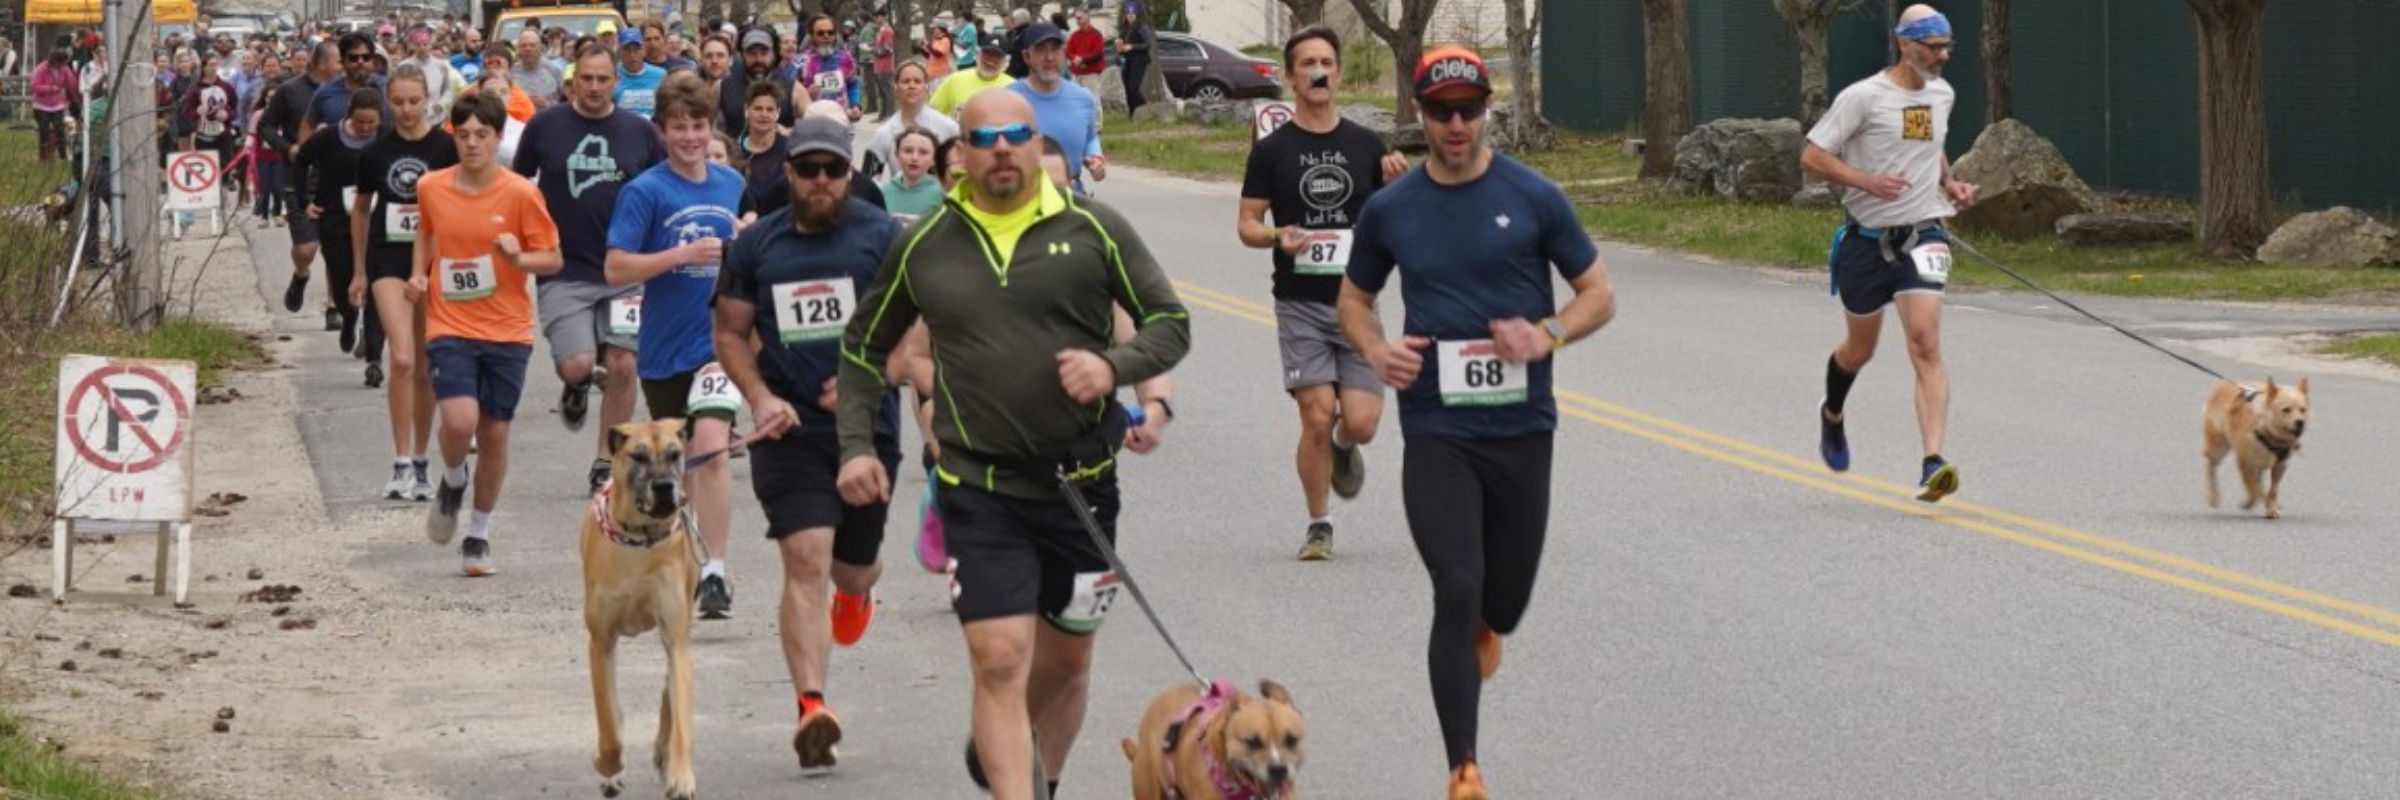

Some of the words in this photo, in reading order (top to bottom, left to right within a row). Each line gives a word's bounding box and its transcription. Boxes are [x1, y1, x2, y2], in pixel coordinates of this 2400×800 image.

[1311, 243, 1337, 262] 87
[454, 271, 479, 290] 98
[791, 297, 843, 326] 128
[1465, 359, 1504, 388] 68
[702, 377, 728, 396] 92
[109, 487, 144, 502] LPW
[1089, 587, 1118, 615] 73
